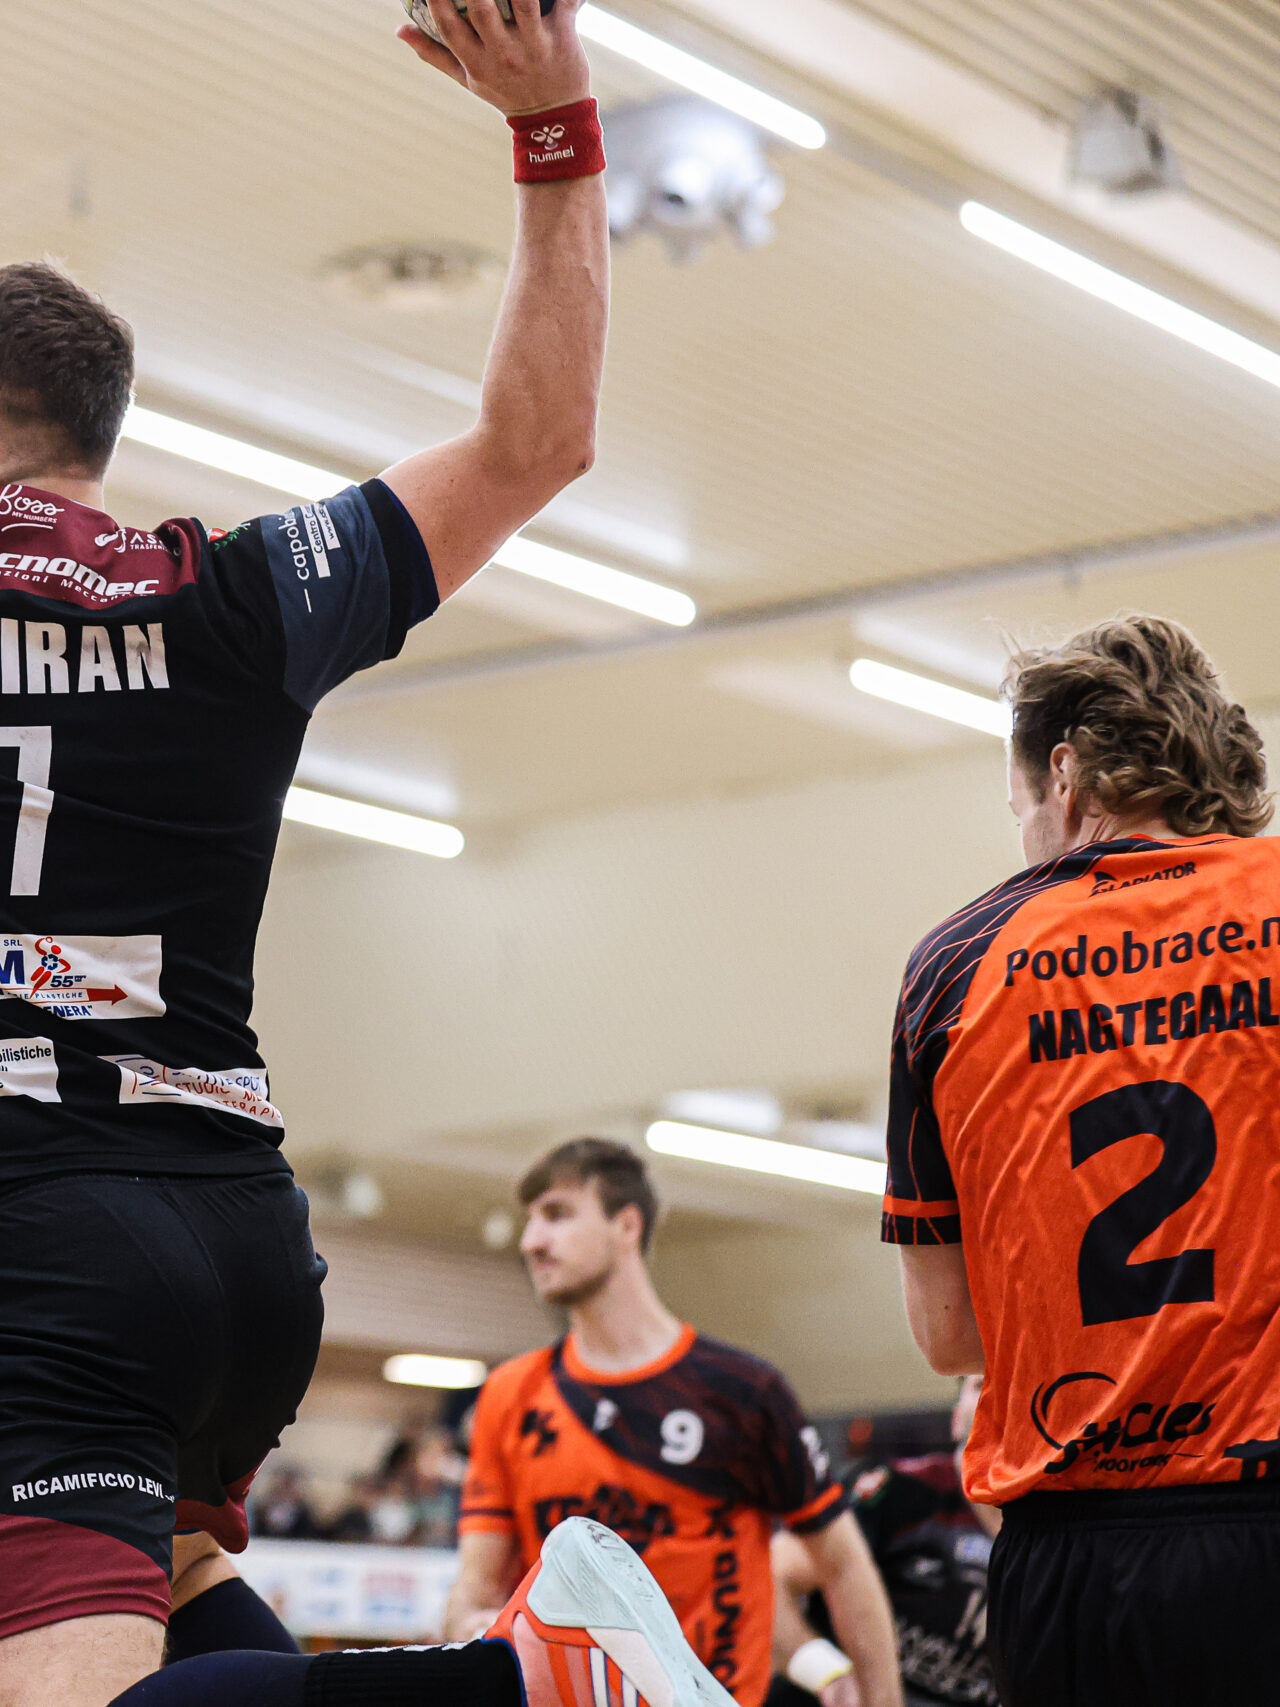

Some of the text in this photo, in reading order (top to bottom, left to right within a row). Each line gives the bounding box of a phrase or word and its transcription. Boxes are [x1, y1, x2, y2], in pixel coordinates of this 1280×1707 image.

[528, 145, 575, 163] hummel
[3, 939, 23, 947] SRL
[1028, 977, 1280, 1064] NAGTEGAAL
[1068, 1079, 1218, 1327] 2
[660, 1408, 705, 1466] 9
[12, 1472, 135, 1502] RICAMIFICIO
